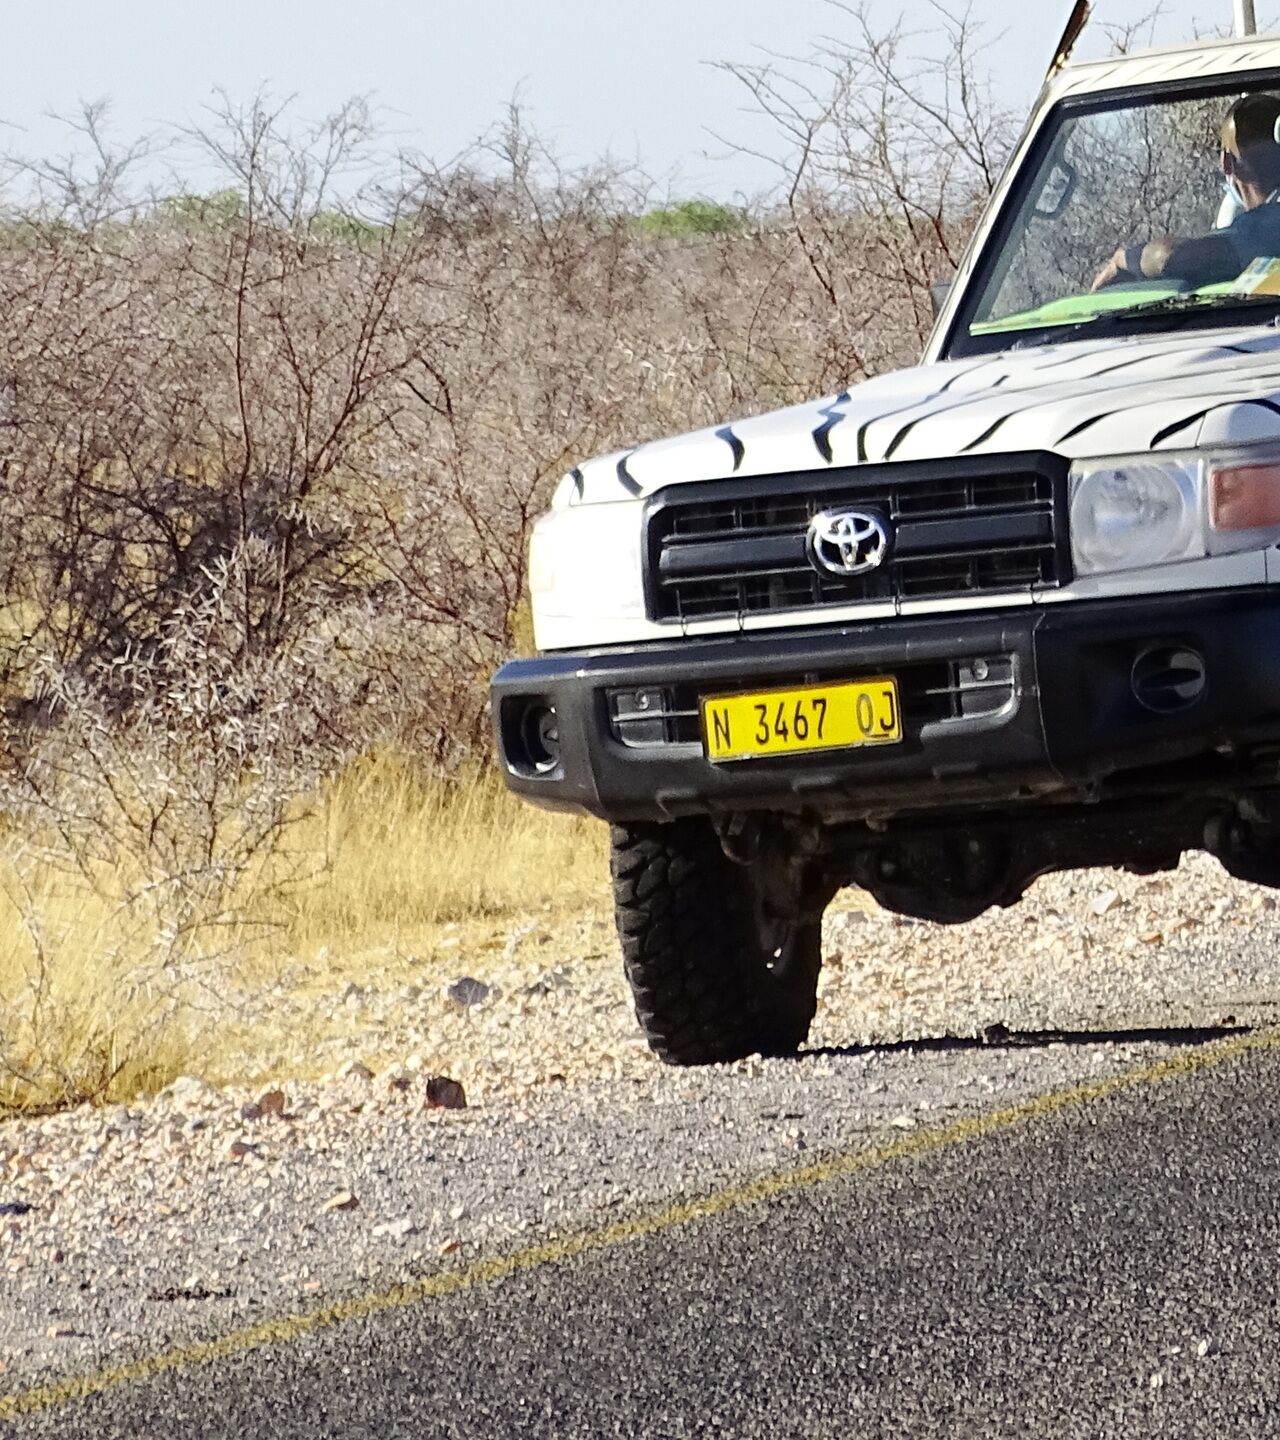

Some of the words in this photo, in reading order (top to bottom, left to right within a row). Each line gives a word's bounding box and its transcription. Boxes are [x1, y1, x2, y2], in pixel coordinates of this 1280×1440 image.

[712, 708, 732, 750] N
[754, 697, 828, 745] 3467
[855, 690, 897, 735] OJ
